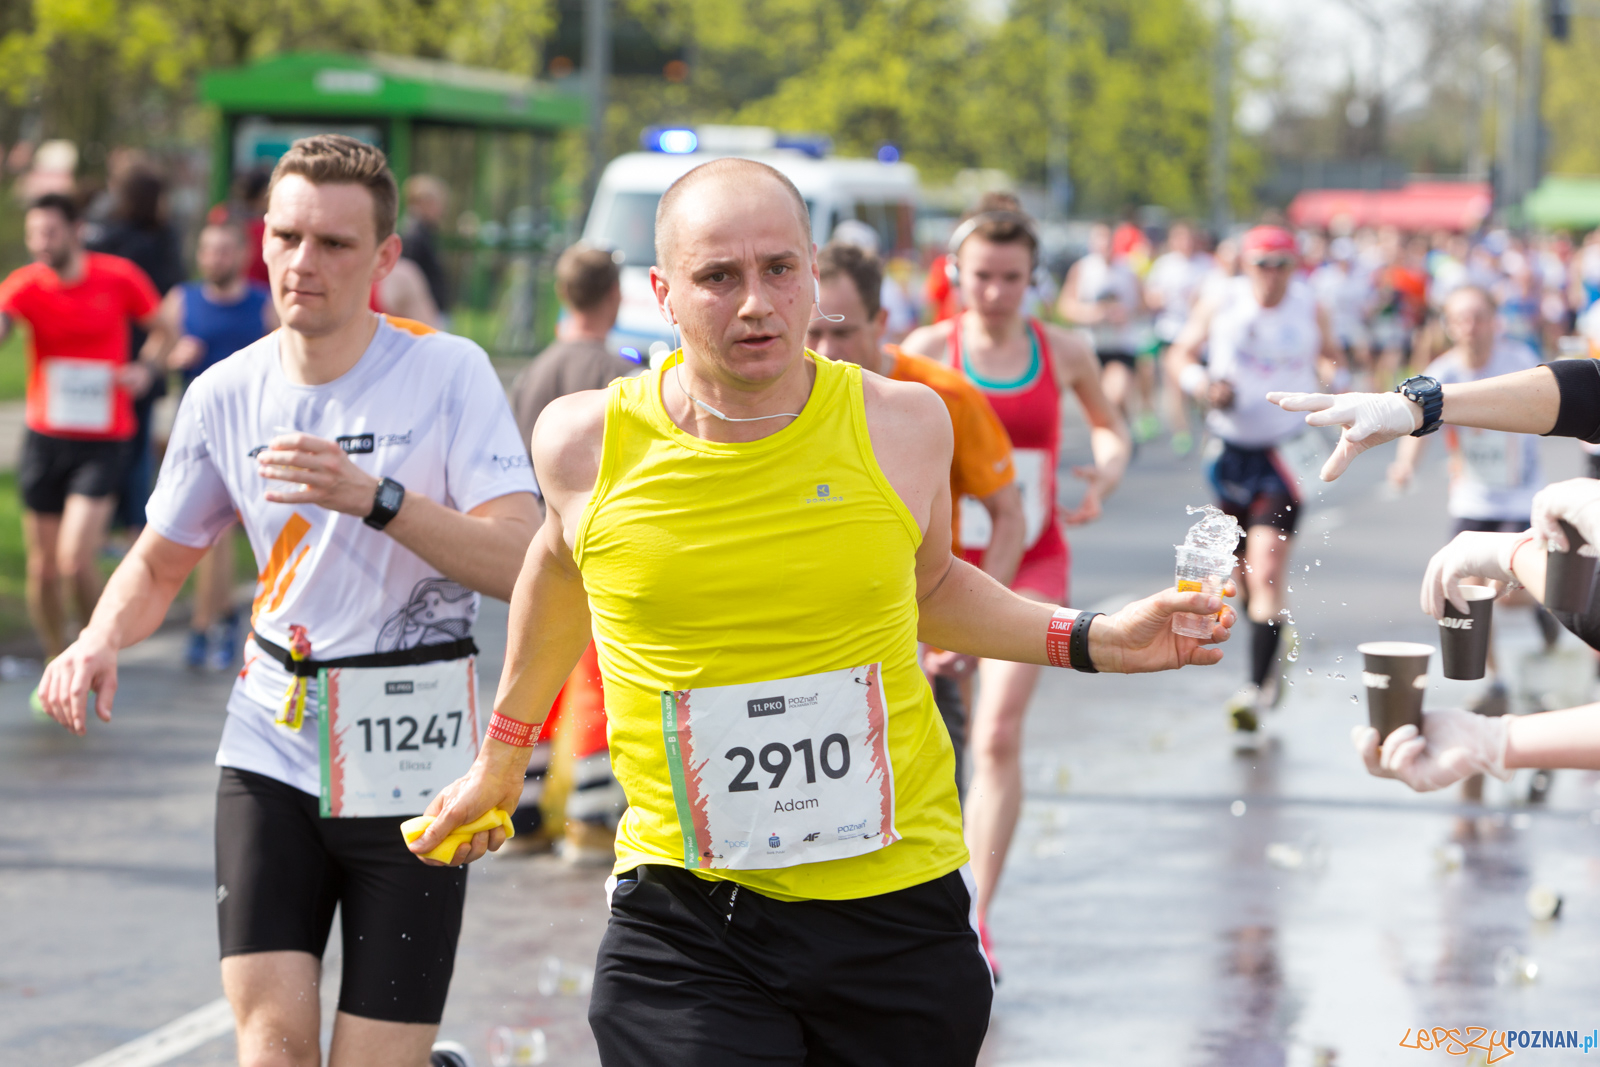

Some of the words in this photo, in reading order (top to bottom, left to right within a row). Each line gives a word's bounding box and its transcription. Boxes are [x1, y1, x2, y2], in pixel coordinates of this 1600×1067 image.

[1050, 620, 1072, 631] START
[665, 696, 673, 727] 15.04.2018
[752, 704, 763, 713] 11.
[763, 701, 783, 711] PKO
[356, 710, 463, 752] 11247
[724, 733, 851, 793] 2910
[773, 797, 819, 813] Adam
